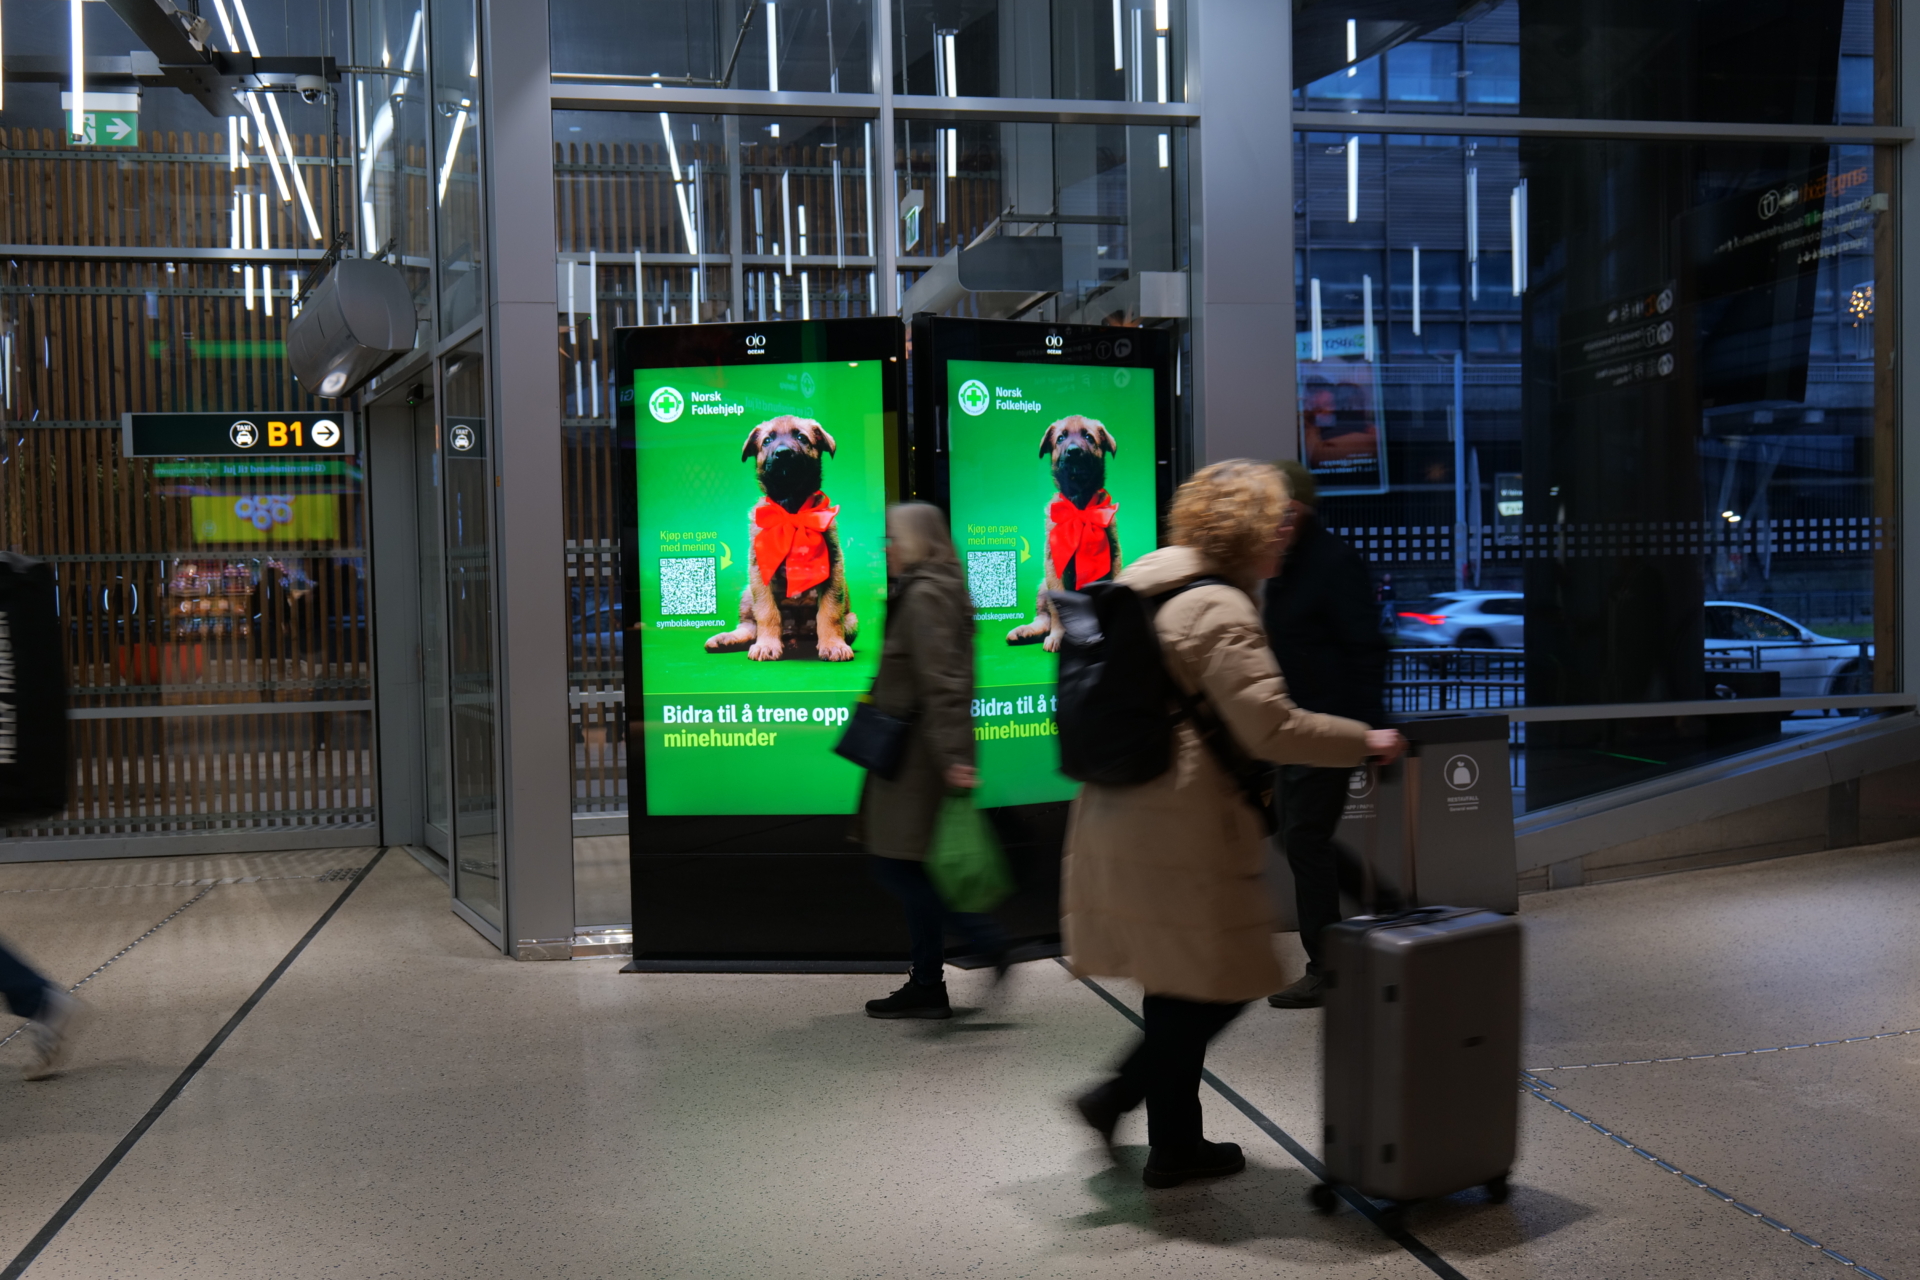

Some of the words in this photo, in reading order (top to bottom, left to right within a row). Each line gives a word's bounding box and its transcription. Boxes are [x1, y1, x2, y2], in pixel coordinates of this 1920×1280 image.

[691, 391, 722, 402] Norsk
[995, 386, 1022, 398] Norsk
[691, 403, 745, 417] Folkehjelp
[996, 399, 1042, 414] Folkehjelp
[267, 421, 303, 447] B1
[967, 524, 987, 535] Kjøp
[987, 525, 998, 533] en
[999, 525, 1018, 535] gave
[660, 531, 681, 542] Kjøp
[695, 531, 717, 541] gave
[967, 536, 986, 546] med
[987, 536, 1017, 547] mening
[660, 542, 681, 552] med
[682, 542, 716, 553] mening
[656, 619, 726, 629] symbolskegaver.no
[970, 697, 1013, 718] Bidra
[1016, 695, 1034, 715] til
[1037, 694, 1047, 713] å
[663, 705, 713, 724] Bidra
[717, 704, 738, 723] til
[741, 703, 753, 723] å
[757, 705, 808, 722] trene
[812, 706, 849, 726] opp
[973, 718, 1059, 741] minehunde
[664, 728, 777, 747] minehunder
